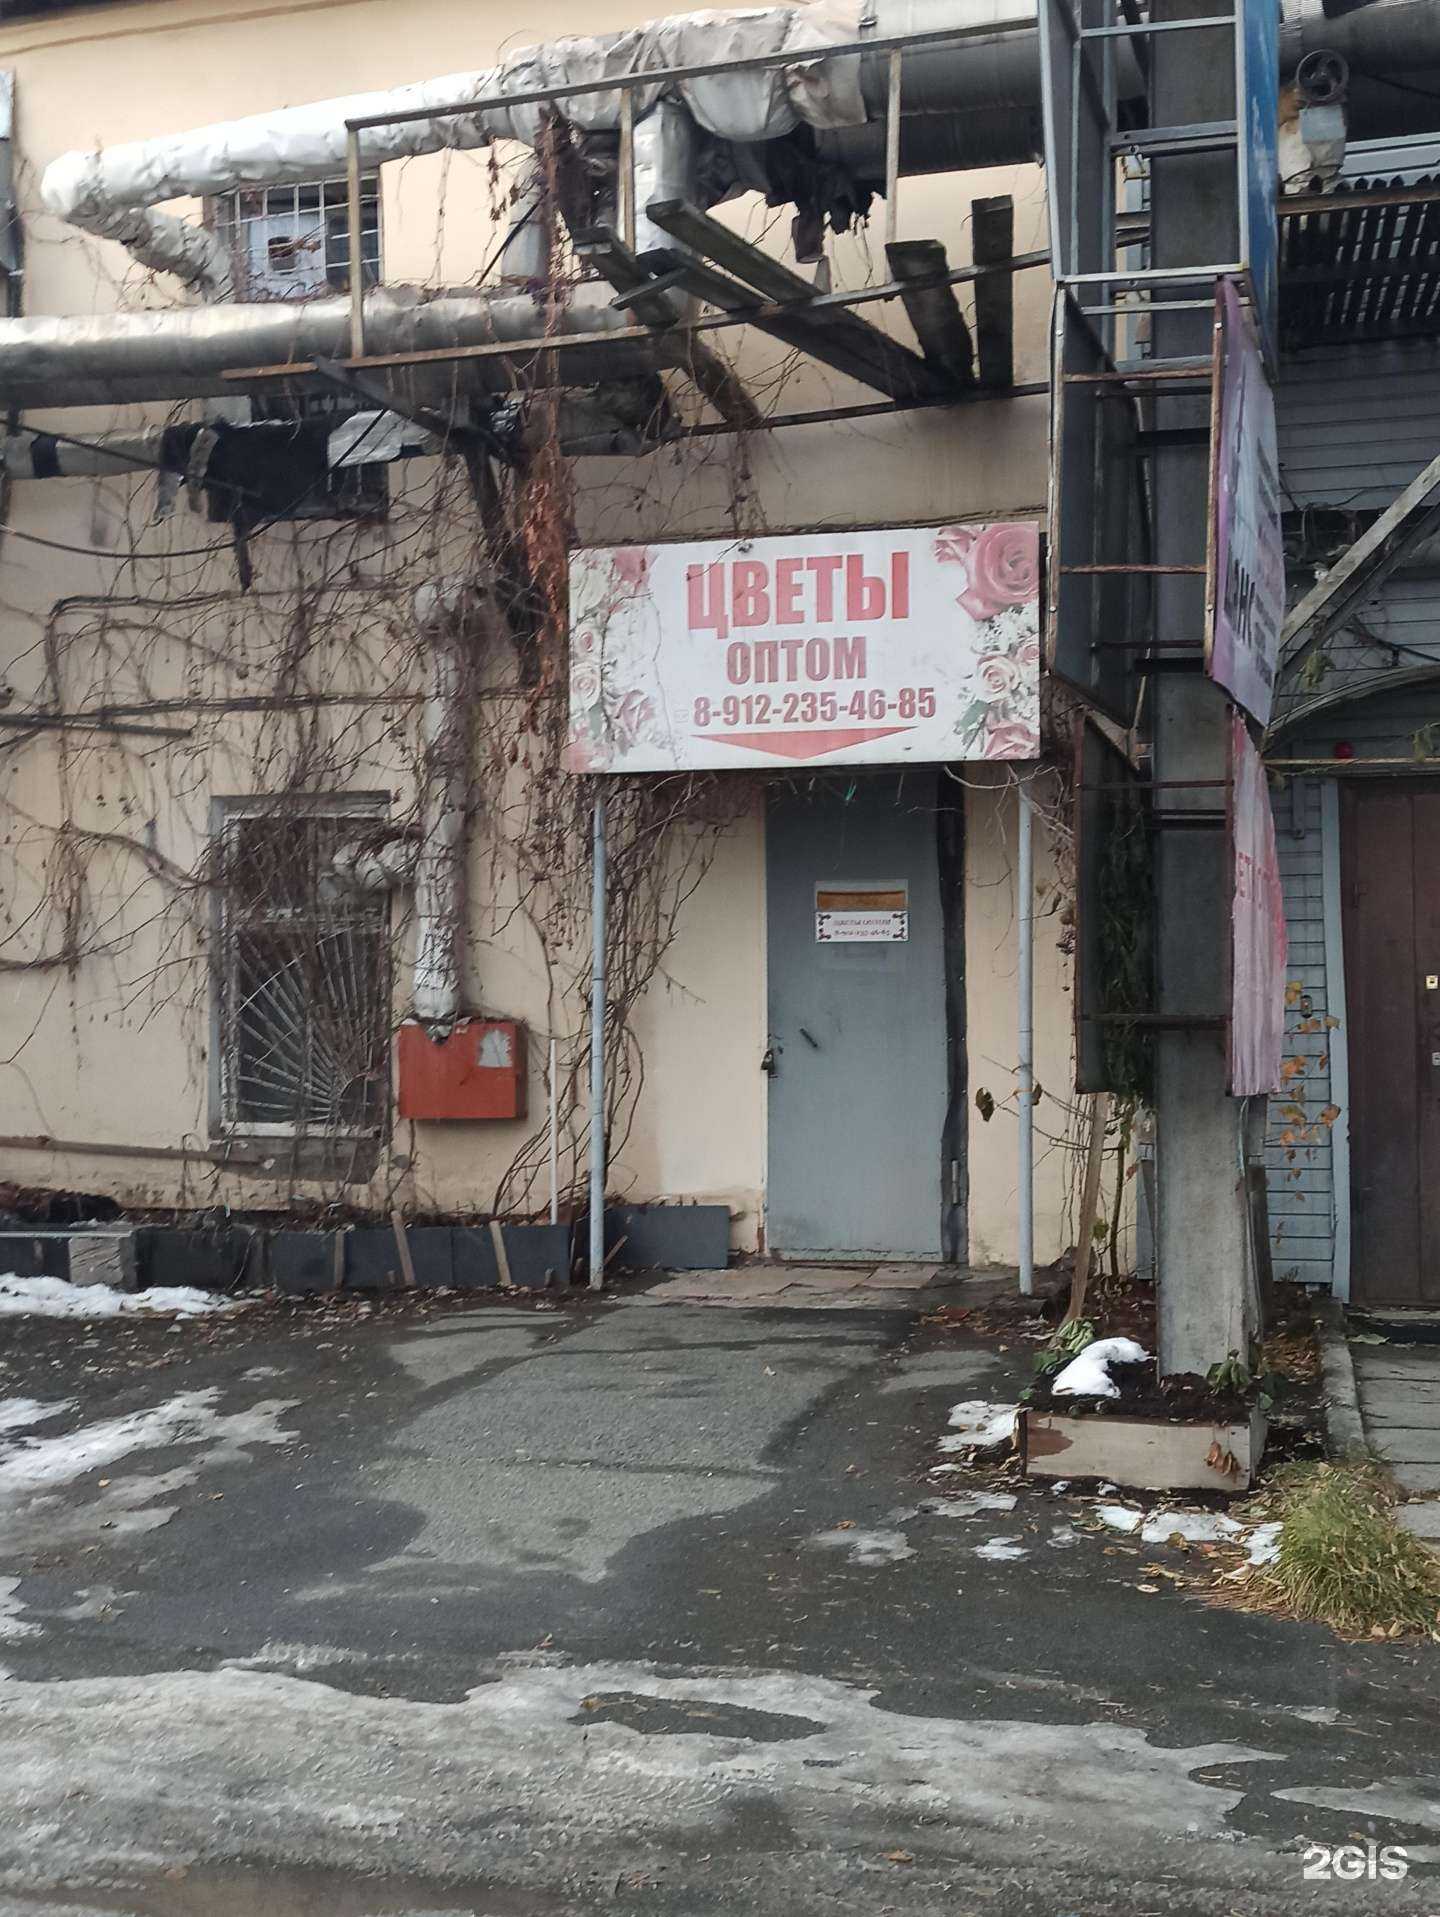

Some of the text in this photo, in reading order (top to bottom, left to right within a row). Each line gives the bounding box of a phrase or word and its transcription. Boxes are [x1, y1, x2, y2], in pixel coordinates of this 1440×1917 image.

[686, 551, 910, 640] ЦВЕТЫ
[726, 636, 867, 685] ОПТОМ
[693, 687, 936, 727] 8-912-235-46-85
